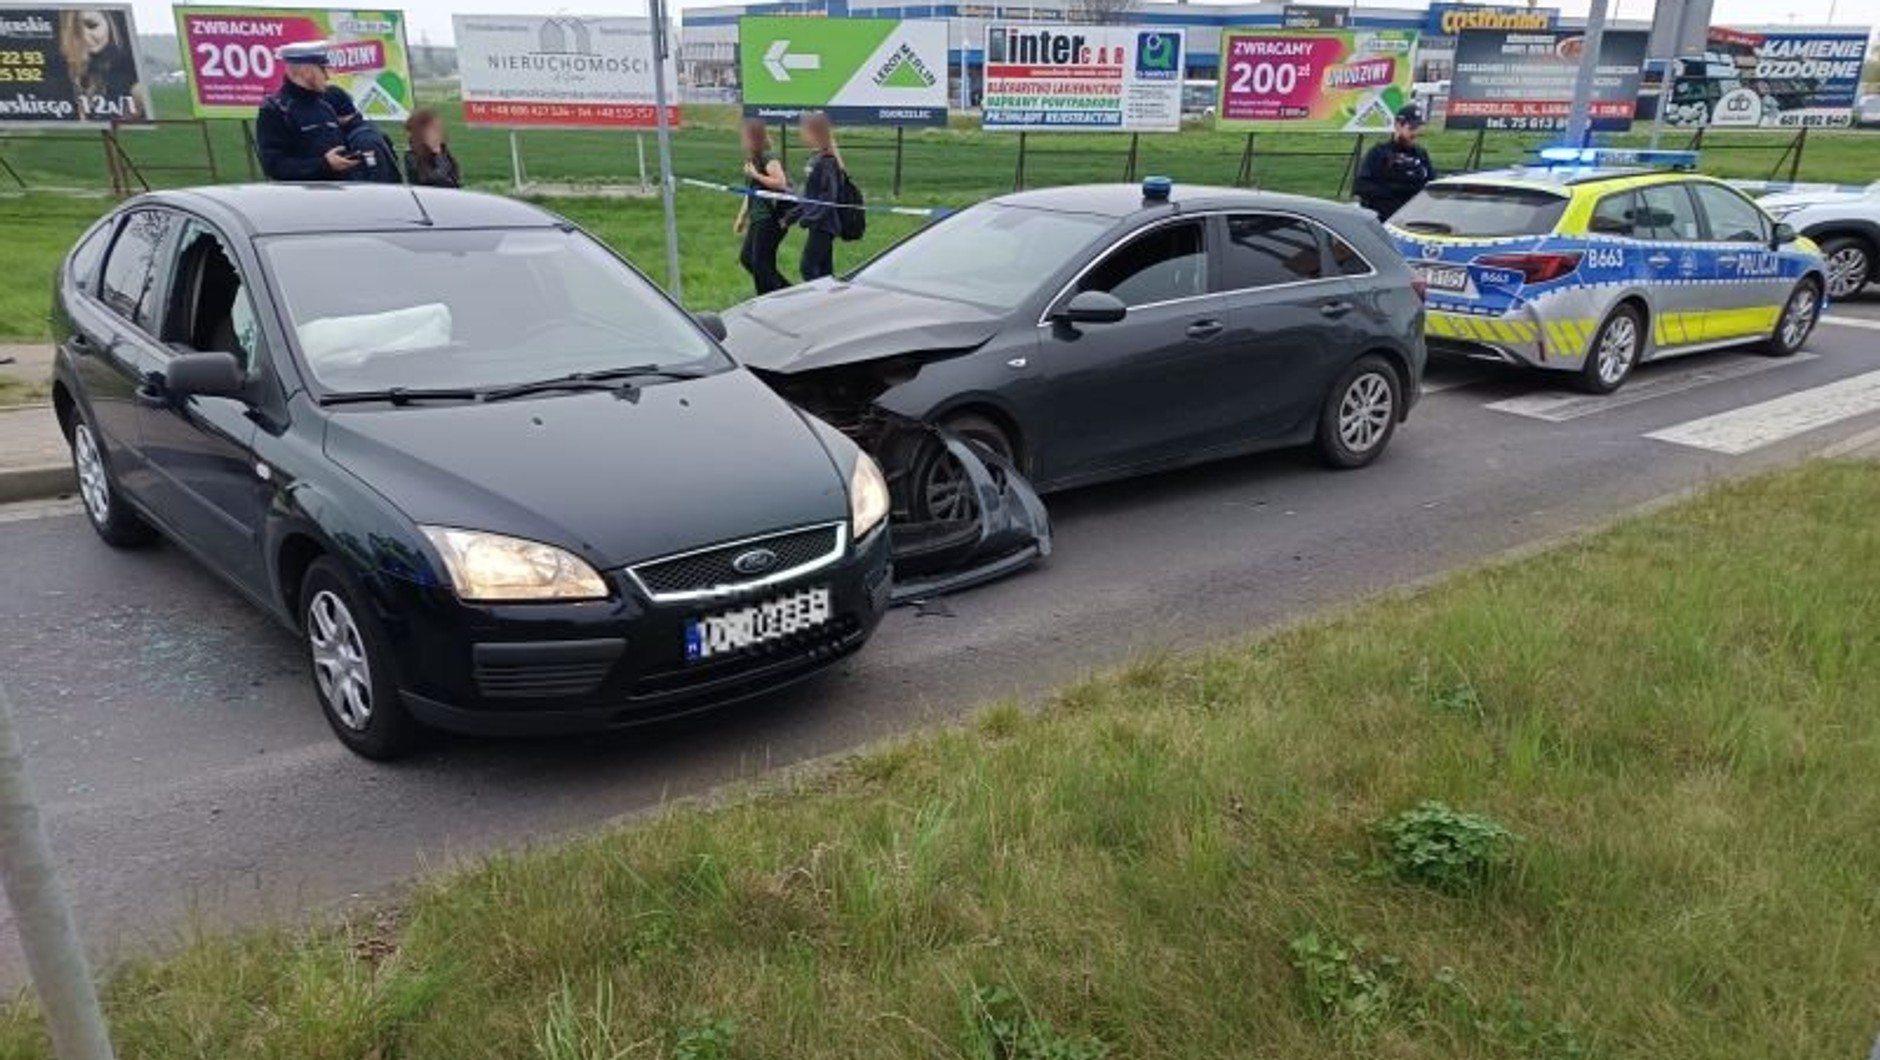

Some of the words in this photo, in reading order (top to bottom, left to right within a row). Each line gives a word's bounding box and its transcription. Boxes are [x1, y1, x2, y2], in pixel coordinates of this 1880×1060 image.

[192, 21, 284, 37] ZWRACAMY
[1009, 29, 1085, 64] inter
[1234, 42, 1314, 56] ZWRACAMY
[1761, 40, 1866, 58] KAMIENIE
[197, 43, 274, 78] 200
[488, 55, 649, 74] NIERUCHOMOŚCI
[1754, 60, 1861, 79] OZDOBNE
[1230, 63, 1297, 94] 200
[1736, 253, 1779, 275] POLICJA
